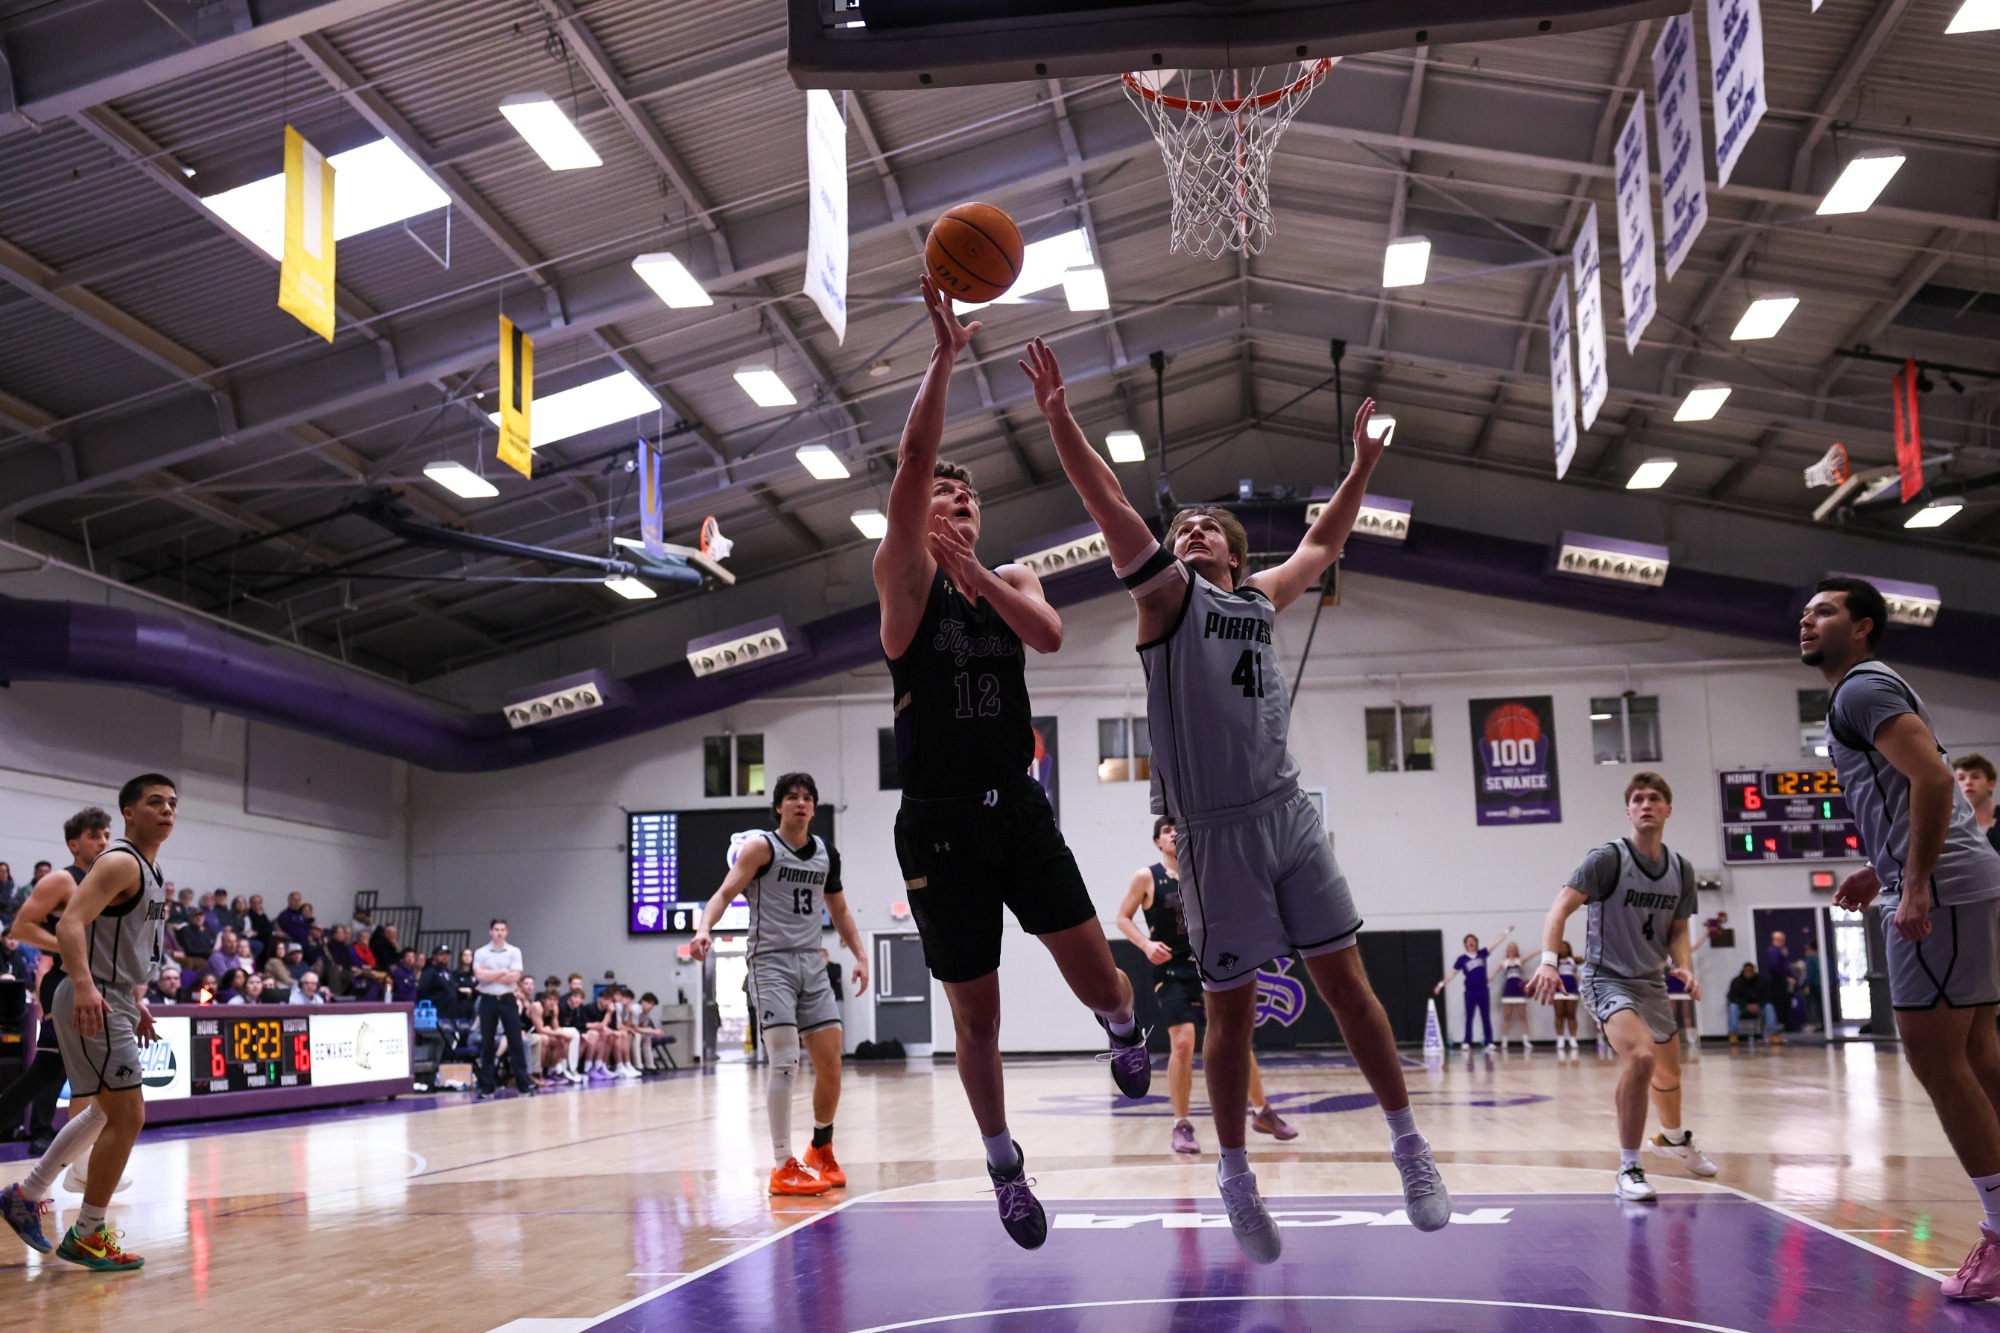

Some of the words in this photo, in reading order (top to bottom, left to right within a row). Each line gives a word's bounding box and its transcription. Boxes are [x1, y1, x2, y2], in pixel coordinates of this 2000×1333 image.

[1231, 649, 1265, 699] 41
[954, 672, 1001, 718] 12
[1491, 738, 1536, 767] 100
[1486, 774, 1548, 791] SEWANEE
[1744, 786, 1762, 810] 6
[777, 866, 826, 886] PIRATES
[792, 887, 814, 915] 13
[1624, 888, 1678, 911] PIRATES
[673, 910, 686, 930] 6
[1642, 913, 1655, 941] 4
[196, 1020, 219, 1035] HOME
[282, 1019, 307, 1033] VISITOR
[233, 1021, 282, 1061] 12:23
[293, 1033, 310, 1072] 16
[210, 1036, 226, 1078] 6
